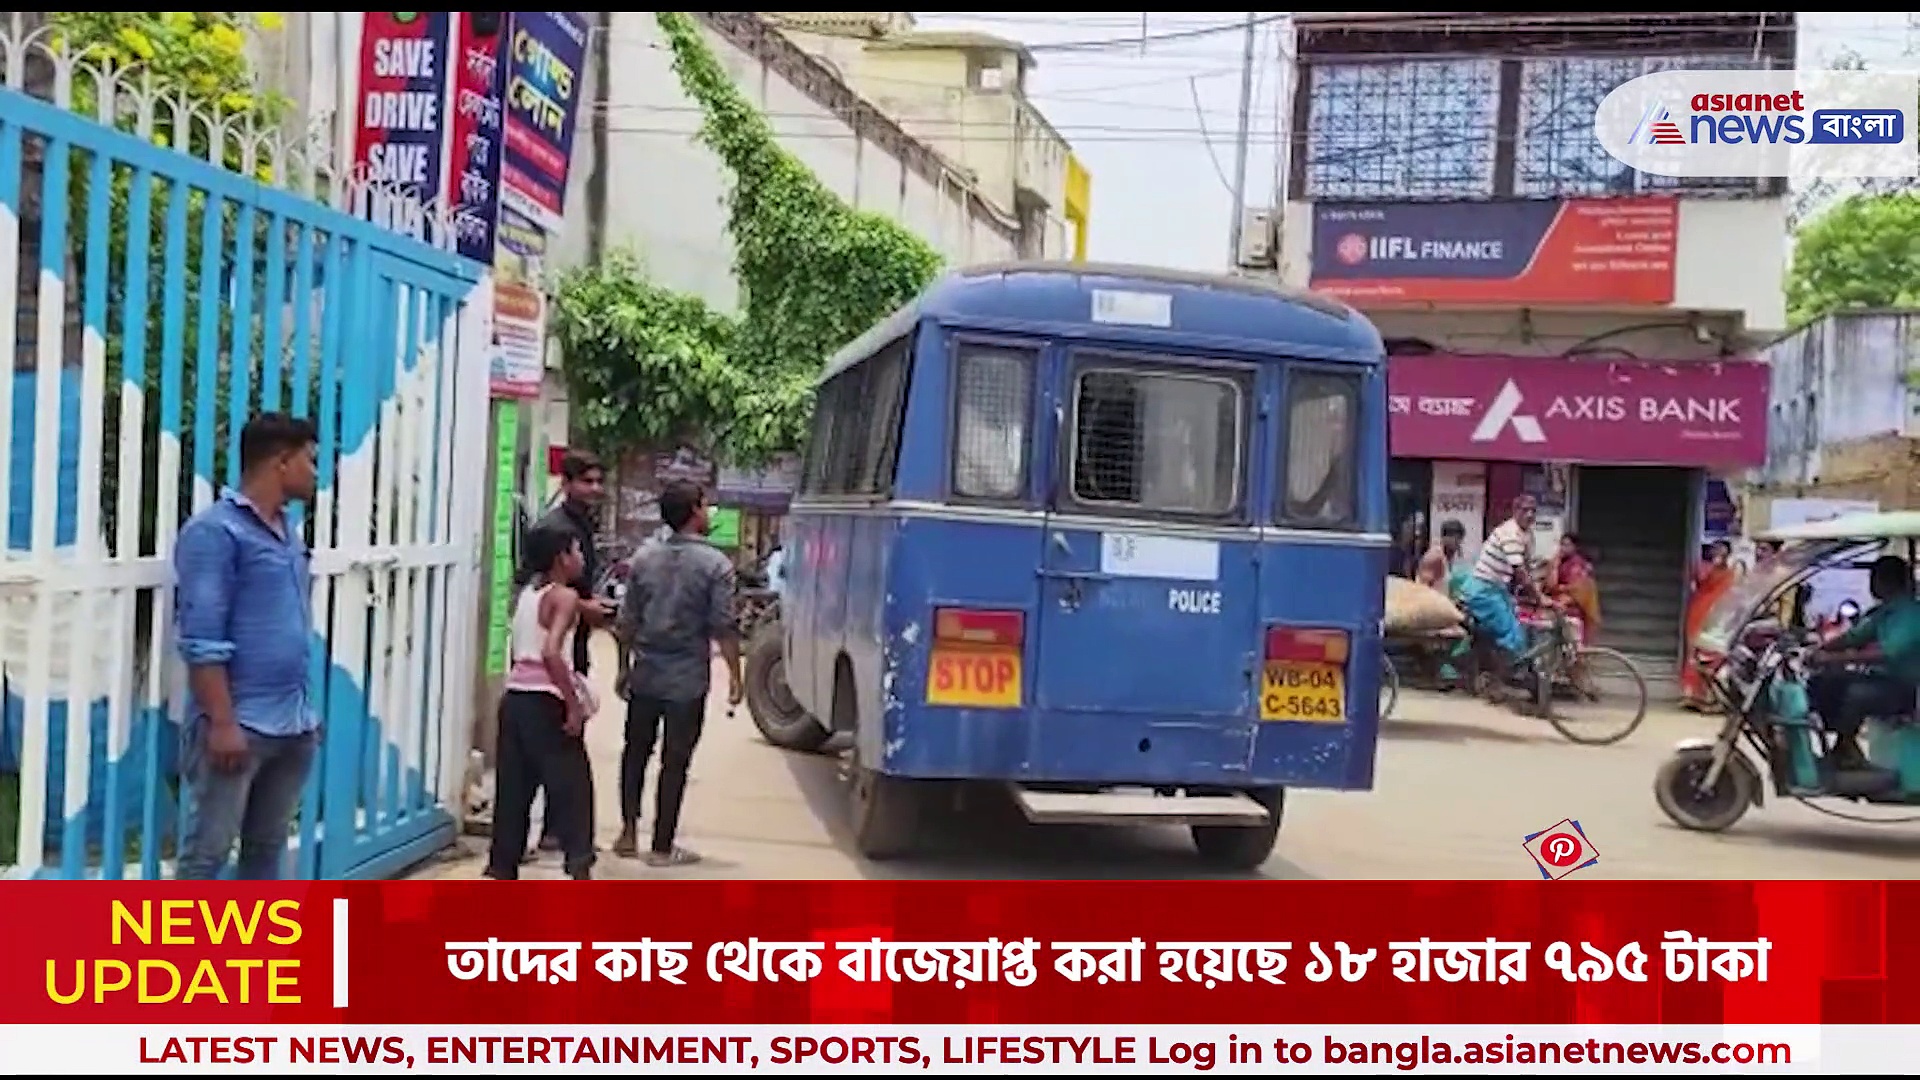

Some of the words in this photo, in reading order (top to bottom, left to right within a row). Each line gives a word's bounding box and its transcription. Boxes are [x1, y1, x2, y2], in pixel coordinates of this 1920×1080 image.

[373, 37, 436, 79] SAVE
[364, 91, 438, 131] DRIVE
[508, 75, 567, 141] লোন
[368, 142, 430, 183] SAVE
[1369, 235, 1418, 260] IIFL
[1420, 239, 1503, 260] FINANCE
[1544, 395, 1626, 421] AXIS
[1638, 397, 1742, 424] BANK
[1168, 587, 1222, 615] POLICE
[934, 656, 1015, 696] STOP
[1265, 693, 1341, 718] C-5643
